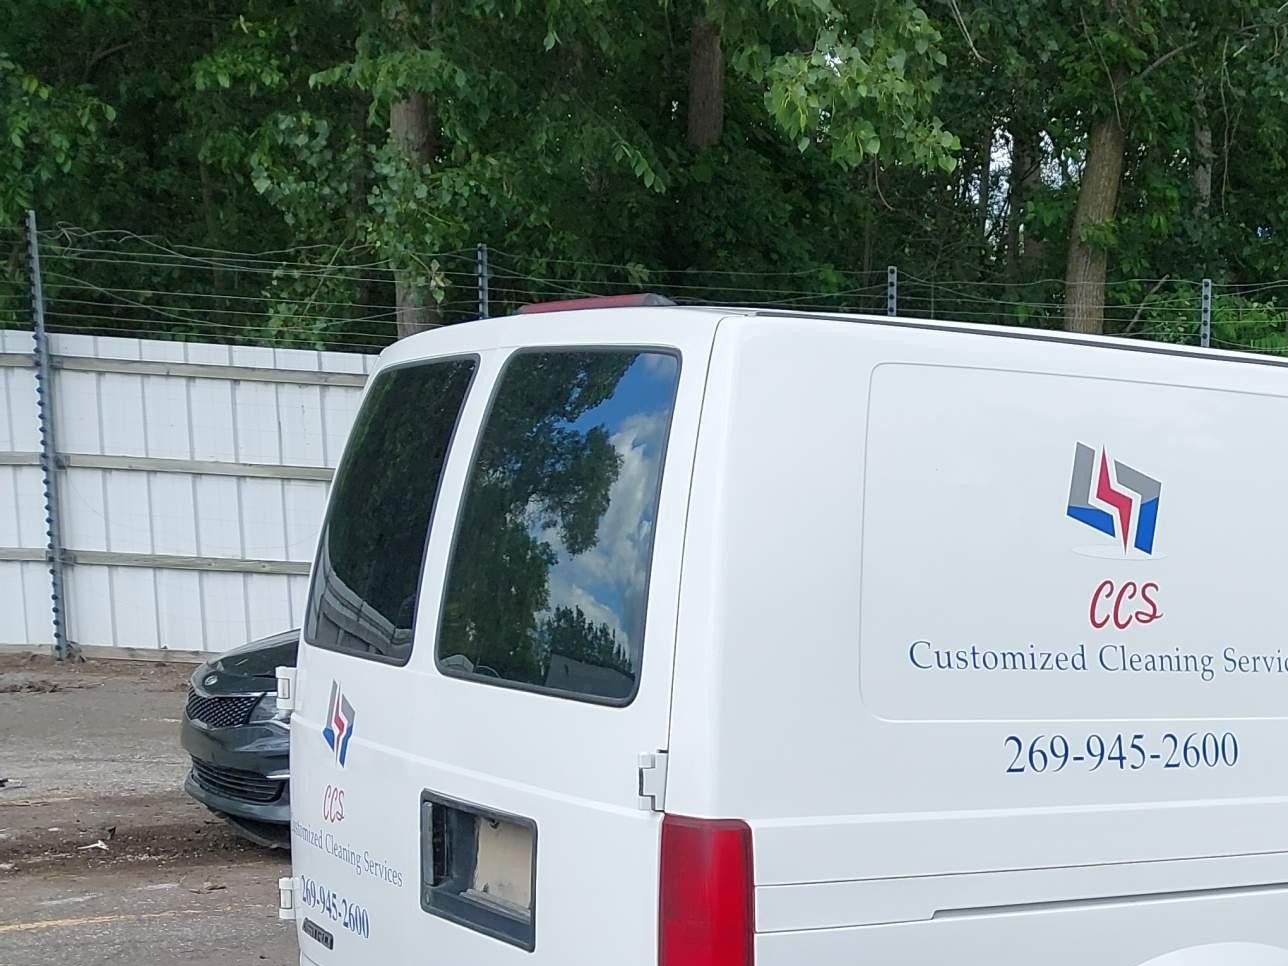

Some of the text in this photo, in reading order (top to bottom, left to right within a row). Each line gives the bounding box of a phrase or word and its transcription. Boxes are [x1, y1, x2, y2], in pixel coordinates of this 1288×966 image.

[1089, 580, 1163, 629] CCS
[909, 641, 1087, 671] Customized
[1099, 645, 1214, 681] Cleaning
[1004, 732, 1239, 773] 269-945-2600
[323, 784, 345, 823] CCS
[325, 833, 361, 875] Cleaning
[363, 850, 403, 888] Services
[301, 874, 370, 939] 269-945-2600
